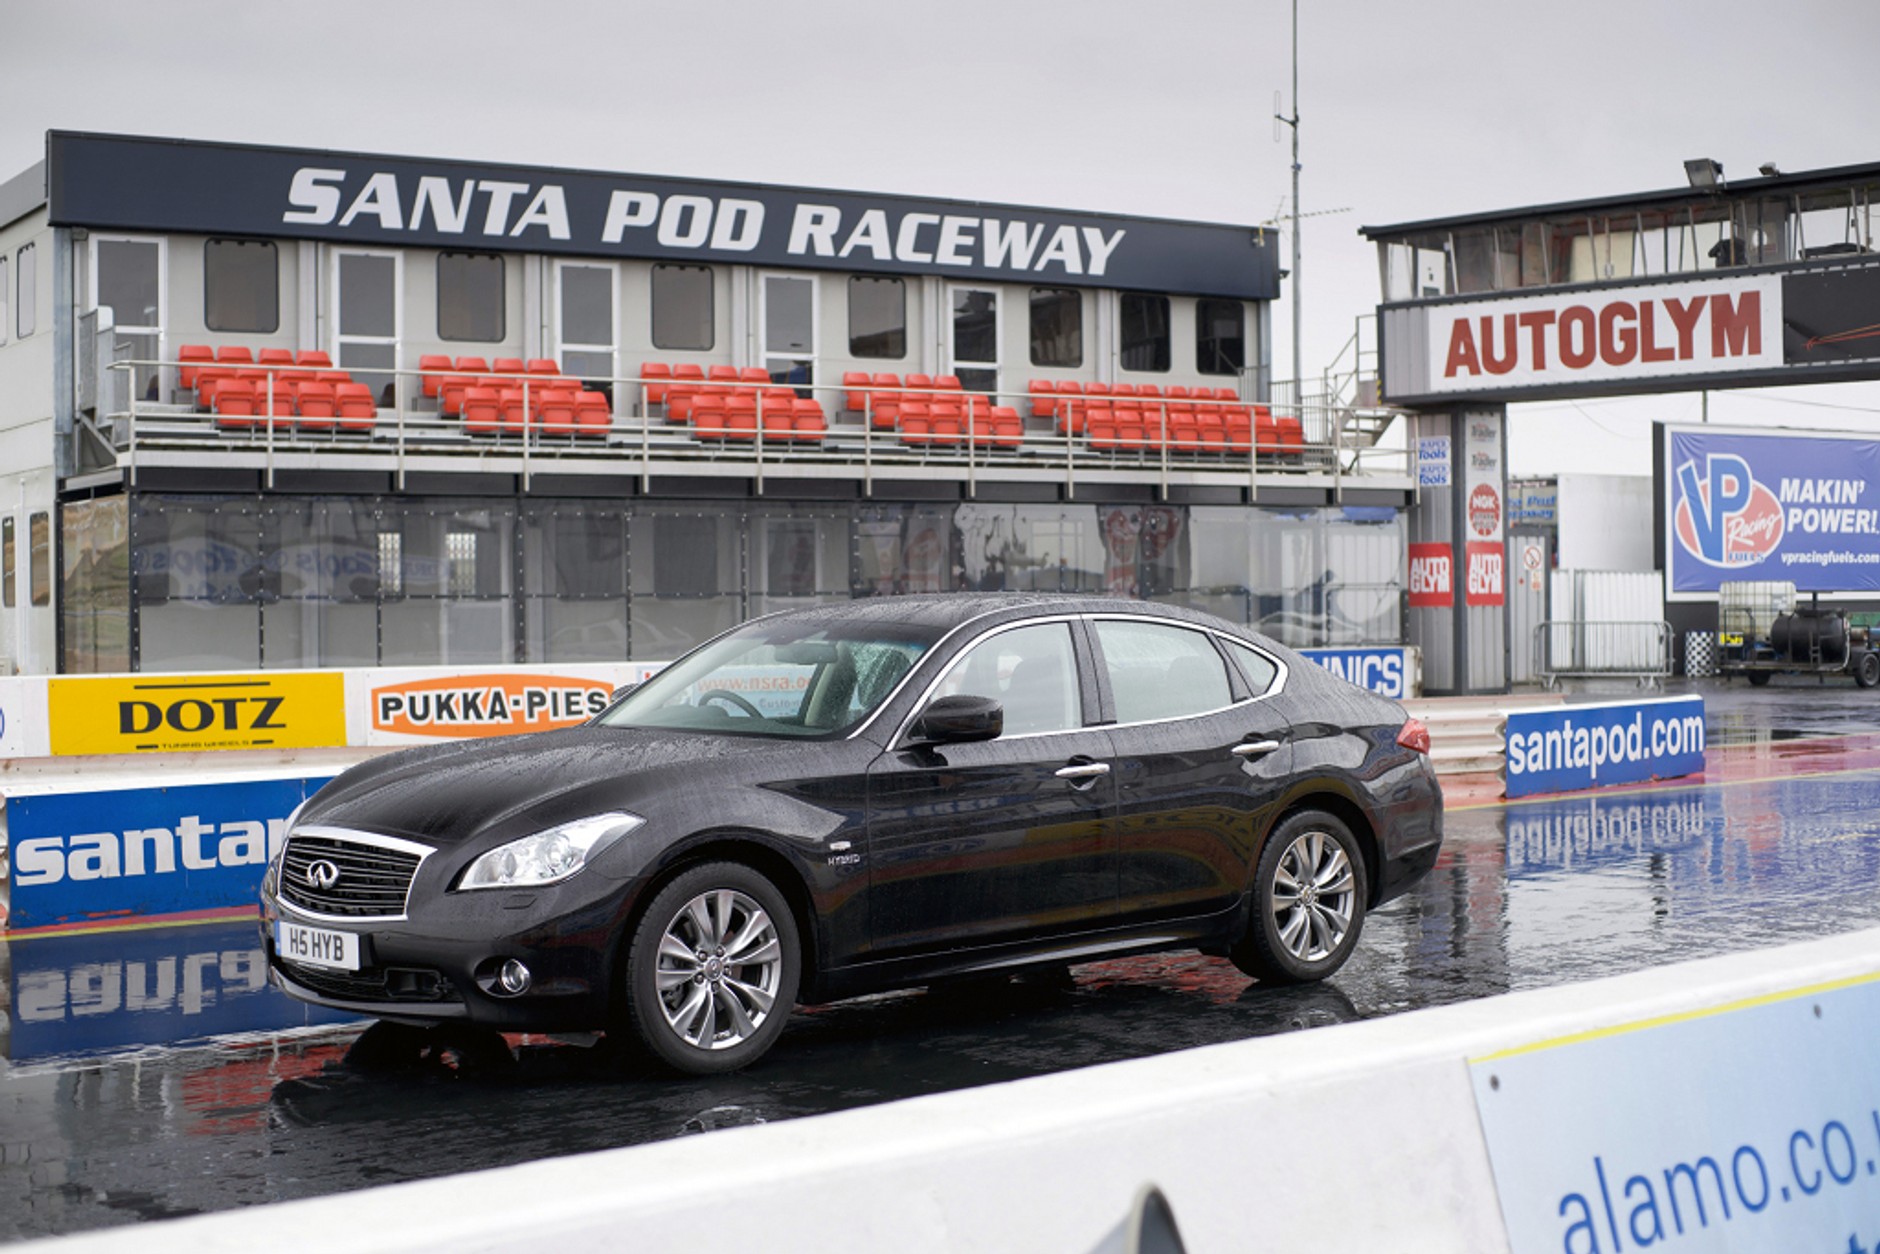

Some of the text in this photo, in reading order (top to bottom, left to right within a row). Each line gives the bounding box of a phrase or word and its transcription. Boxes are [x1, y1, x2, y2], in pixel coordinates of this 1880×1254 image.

[283, 168, 1126, 276] SANTA POD RACEWAY
[1444, 290, 1762, 378] AUTOGLYM
[1472, 495, 1496, 509] NGK
[1780, 477, 1865, 504] MAKIN'
[1677, 454, 1752, 566] VP
[1787, 508, 1877, 534] POWER!
[1728, 511, 1781, 550] Racing
[1411, 556, 1449, 575] AUTO
[1470, 553, 1502, 574] AUTO
[1410, 573, 1450, 593] GLYM
[1469, 573, 1502, 594] GLYM
[119, 696, 287, 735] DOTZ
[380, 688, 609, 724] PUKKA-PIES
[1508, 711, 1704, 778] santapod.com
[290, 927, 344, 961] H5 HYB
[1557, 1109, 1880, 1254] alamo.co.
